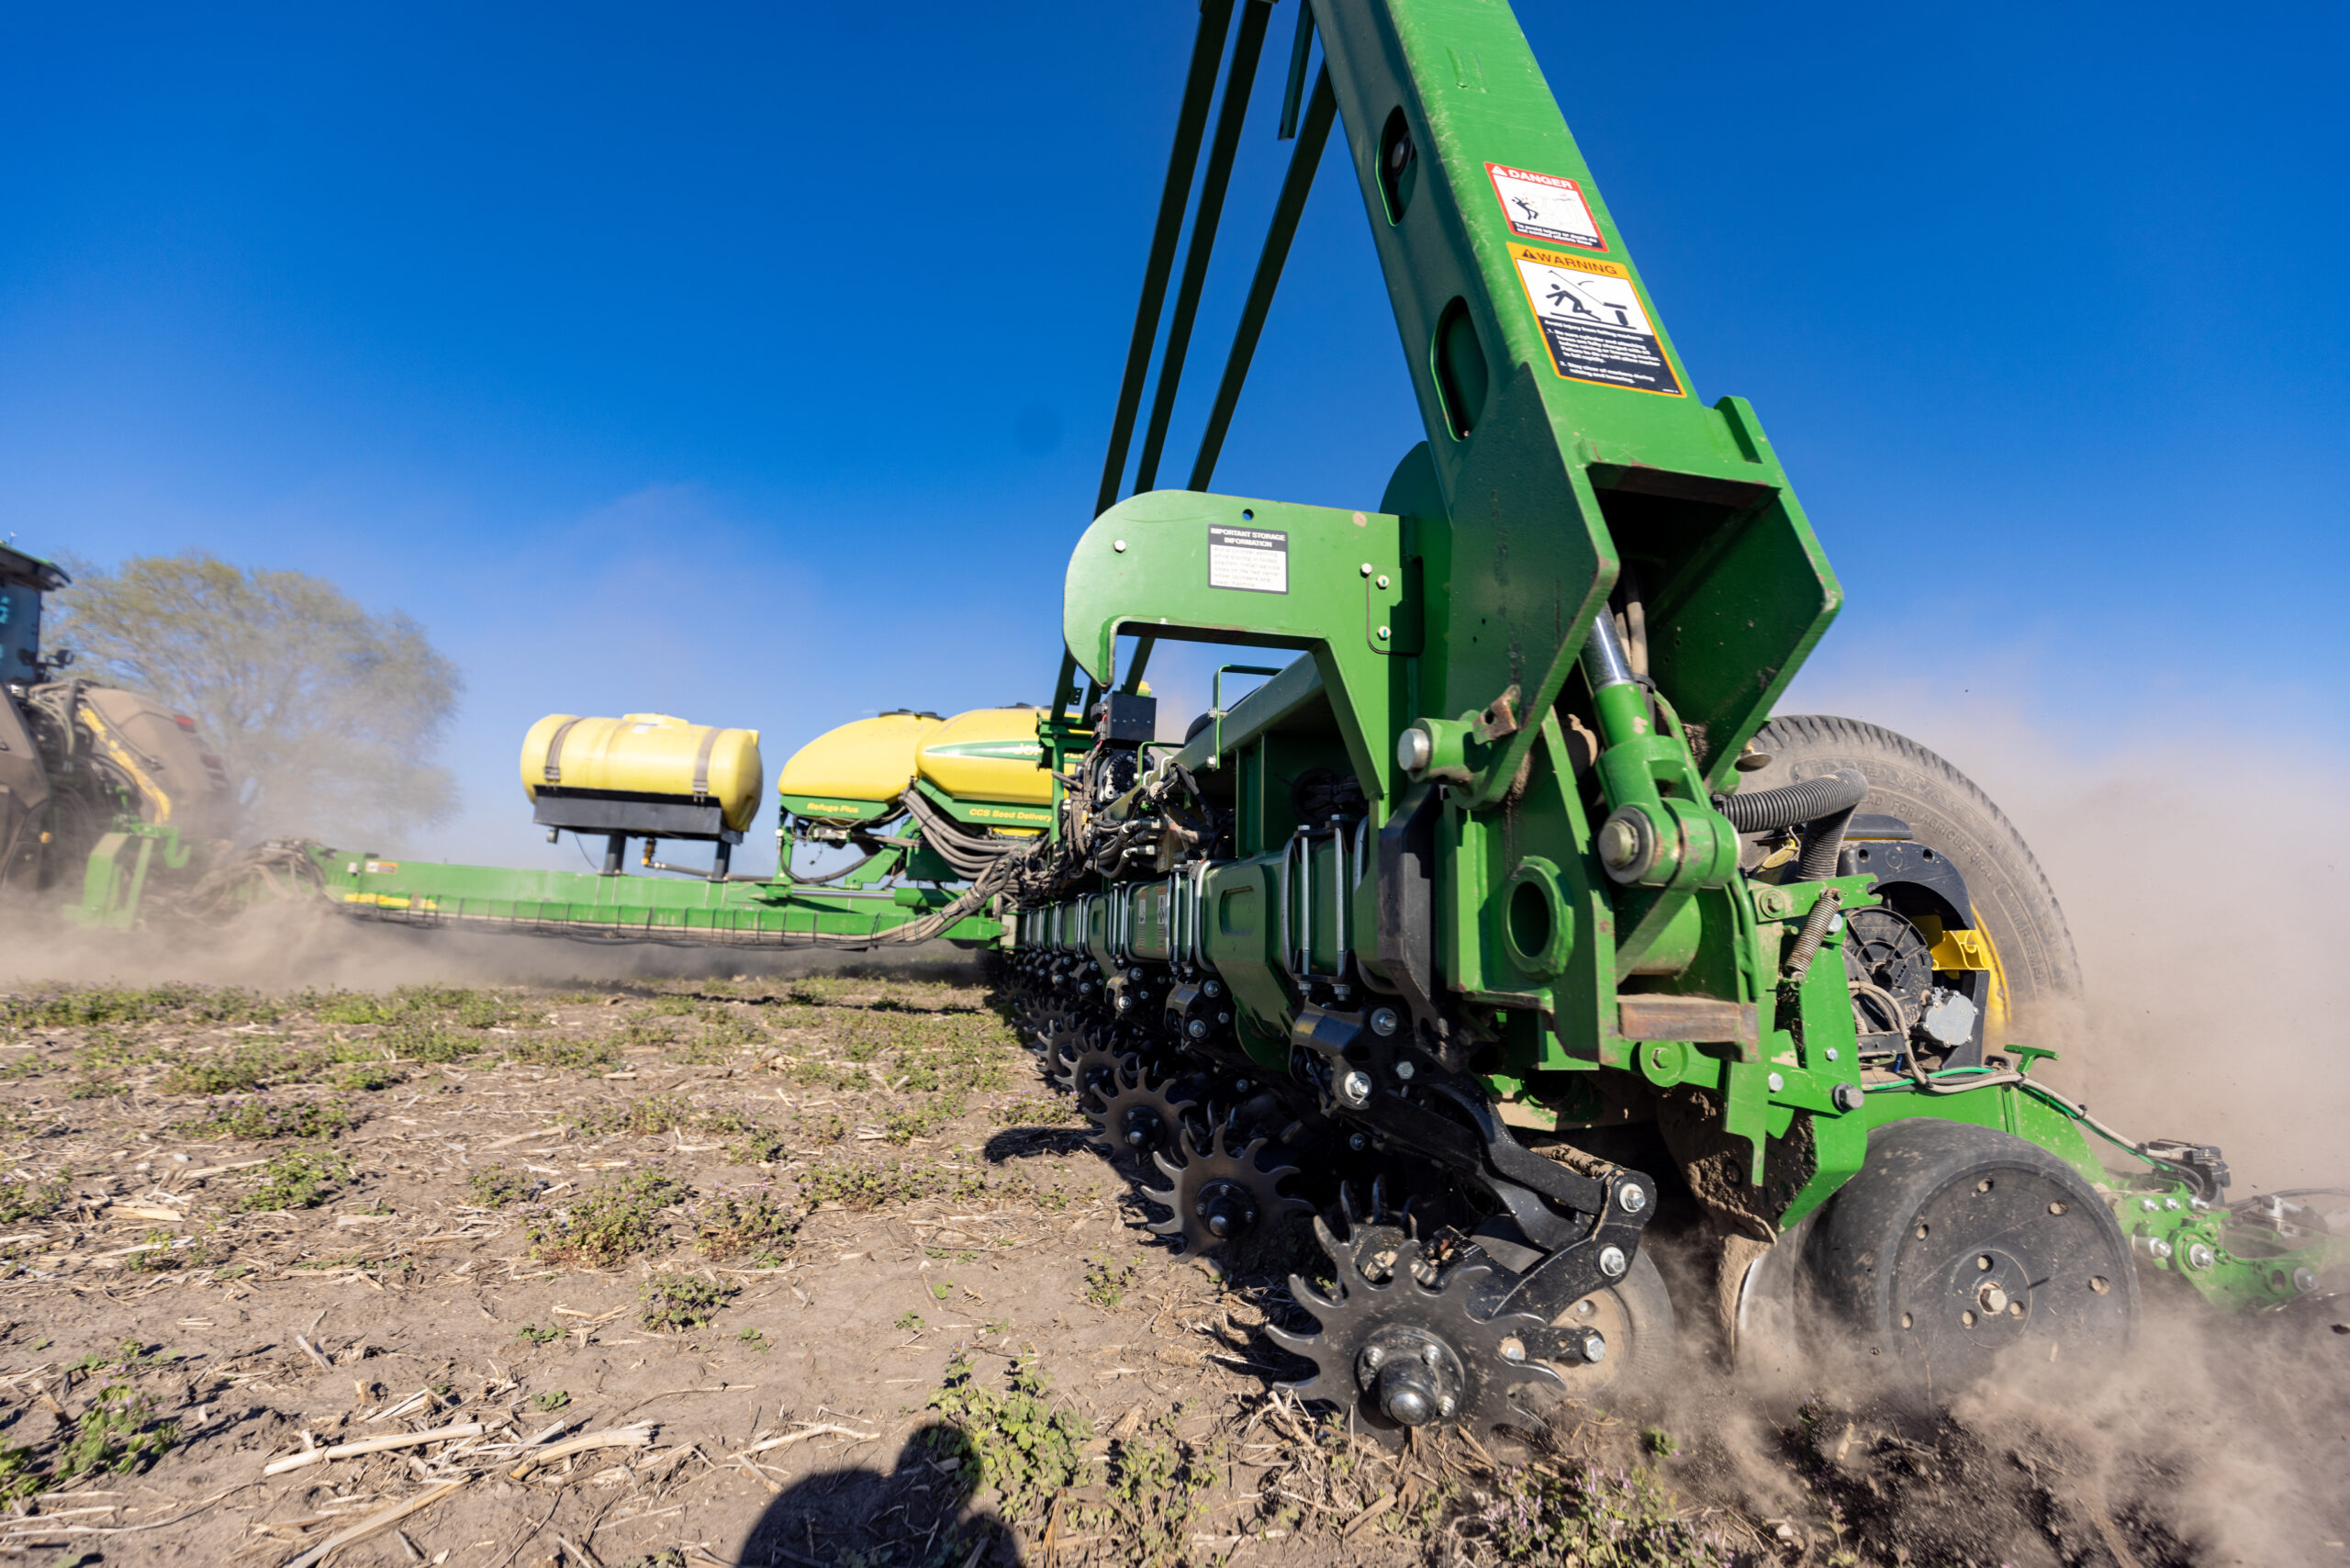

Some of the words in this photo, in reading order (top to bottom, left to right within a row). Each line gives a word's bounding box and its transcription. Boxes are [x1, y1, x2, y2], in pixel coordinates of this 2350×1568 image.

[1508, 169, 1572, 189] DANGER
[1536, 252, 1617, 274] WARNING
[1211, 528, 1250, 537] IMPORTANT
[1252, 532, 1285, 542] STORAGE
[1225, 537, 1272, 547] INFORMATION
[807, 802, 839, 813] Refuge
[840, 805, 859, 813] Plus
[969, 808, 990, 817] CCS
[991, 810, 1016, 818] Seed
[1017, 812, 1052, 823] Delivery
[1891, 800, 1915, 817] FOR
[1922, 813, 1993, 881] AGRICULTURAL
